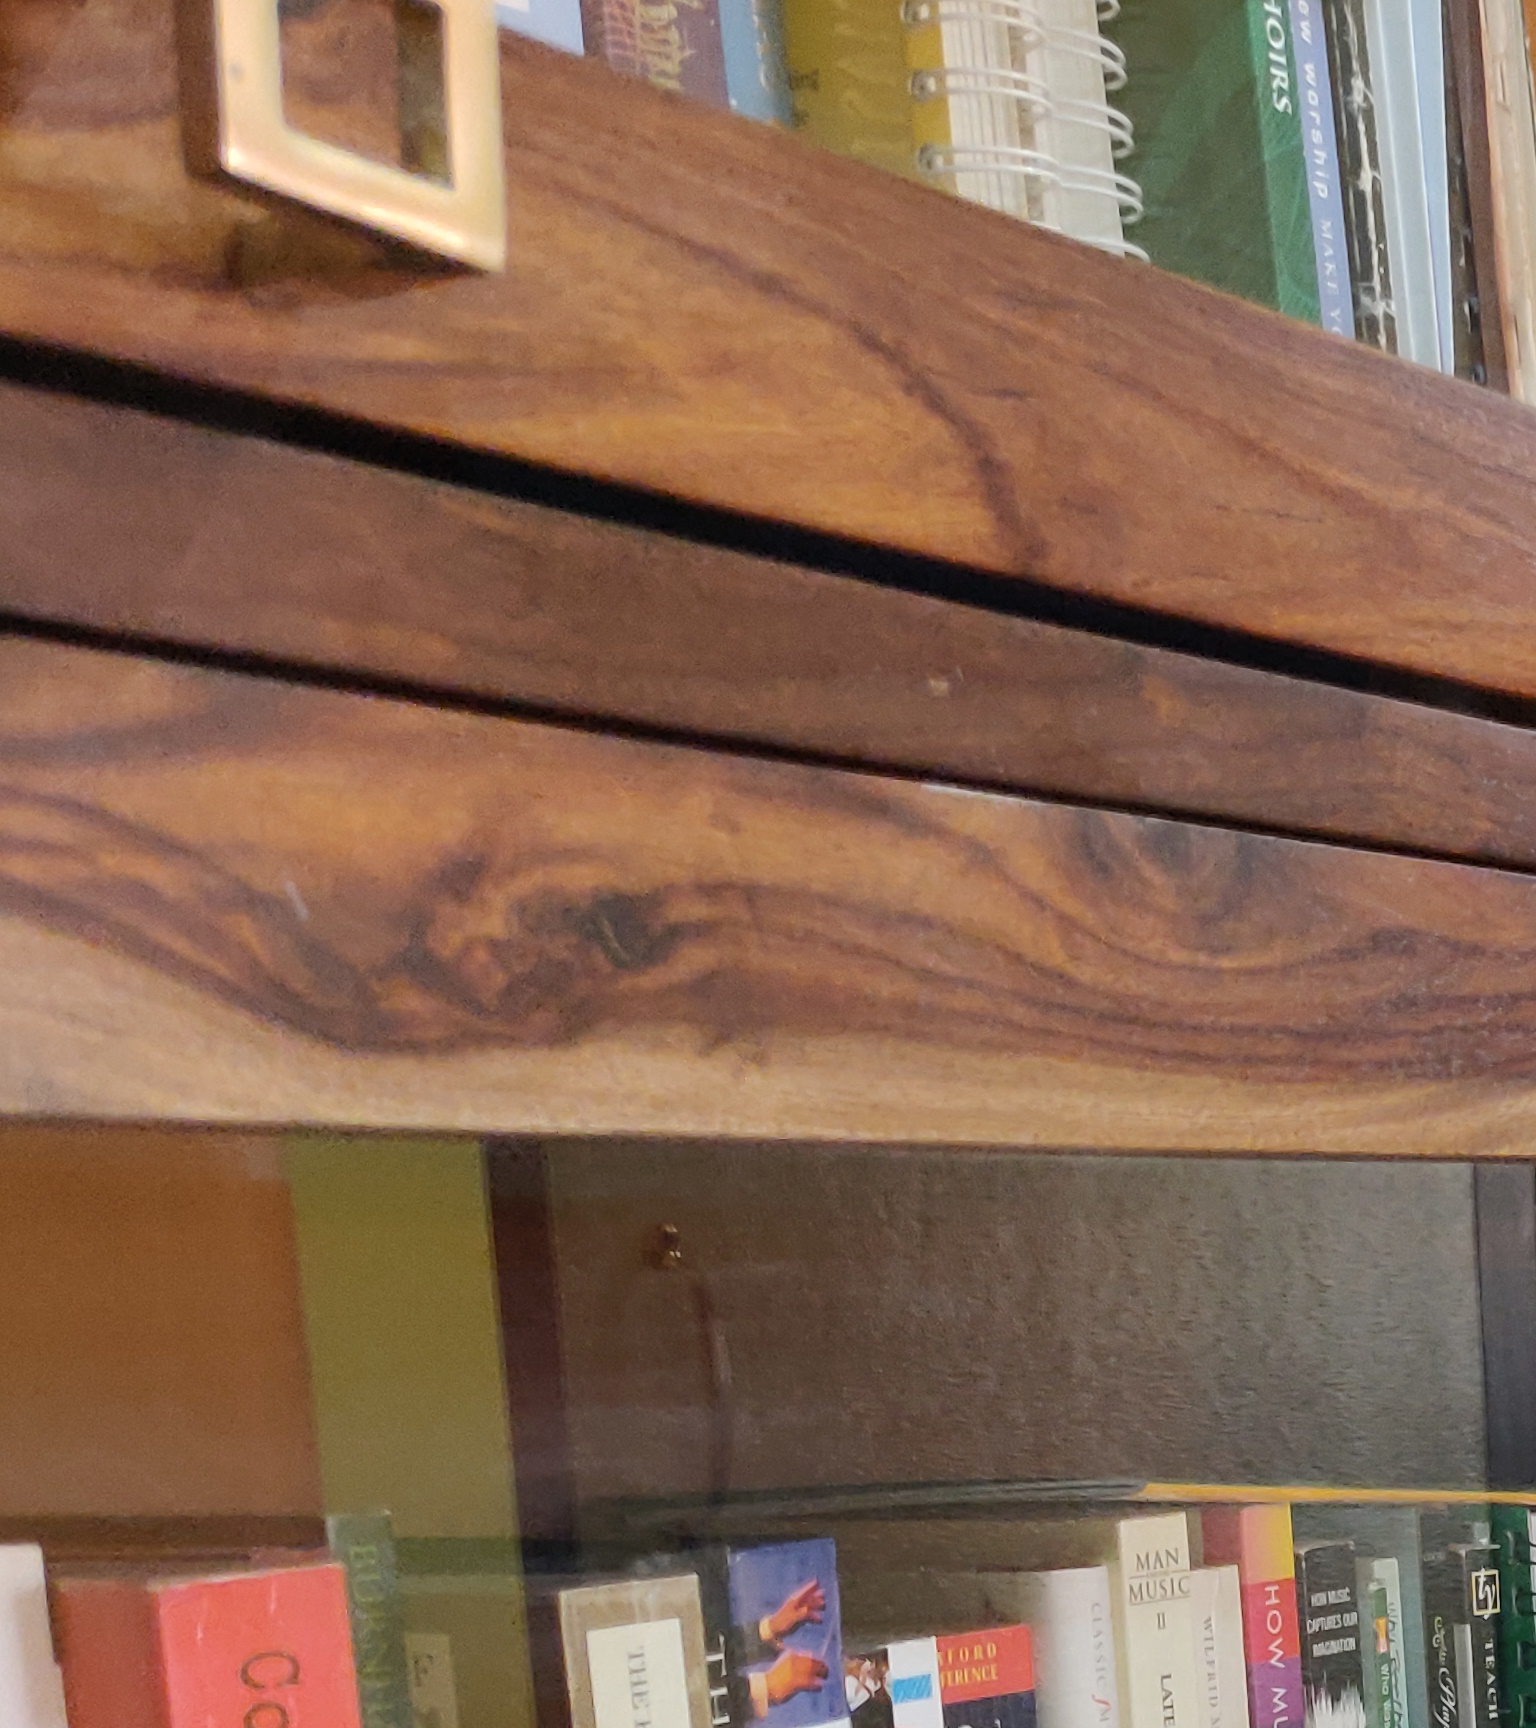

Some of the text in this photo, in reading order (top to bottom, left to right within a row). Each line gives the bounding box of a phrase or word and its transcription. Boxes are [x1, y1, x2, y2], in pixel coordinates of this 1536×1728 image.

[1302, 62, 1331, 200] worship
[1128, 1575, 1191, 1603] MUSIC
[1134, 1547, 1181, 1573] MAN
[1263, 1586, 1286, 1669] HOW
[625, 1644, 655, 1716] THE
[1202, 1614, 1220, 1709] WILFRID
[1380, 1662, 1390, 1696] Who
[1159, 1672, 1176, 1728] LATE
